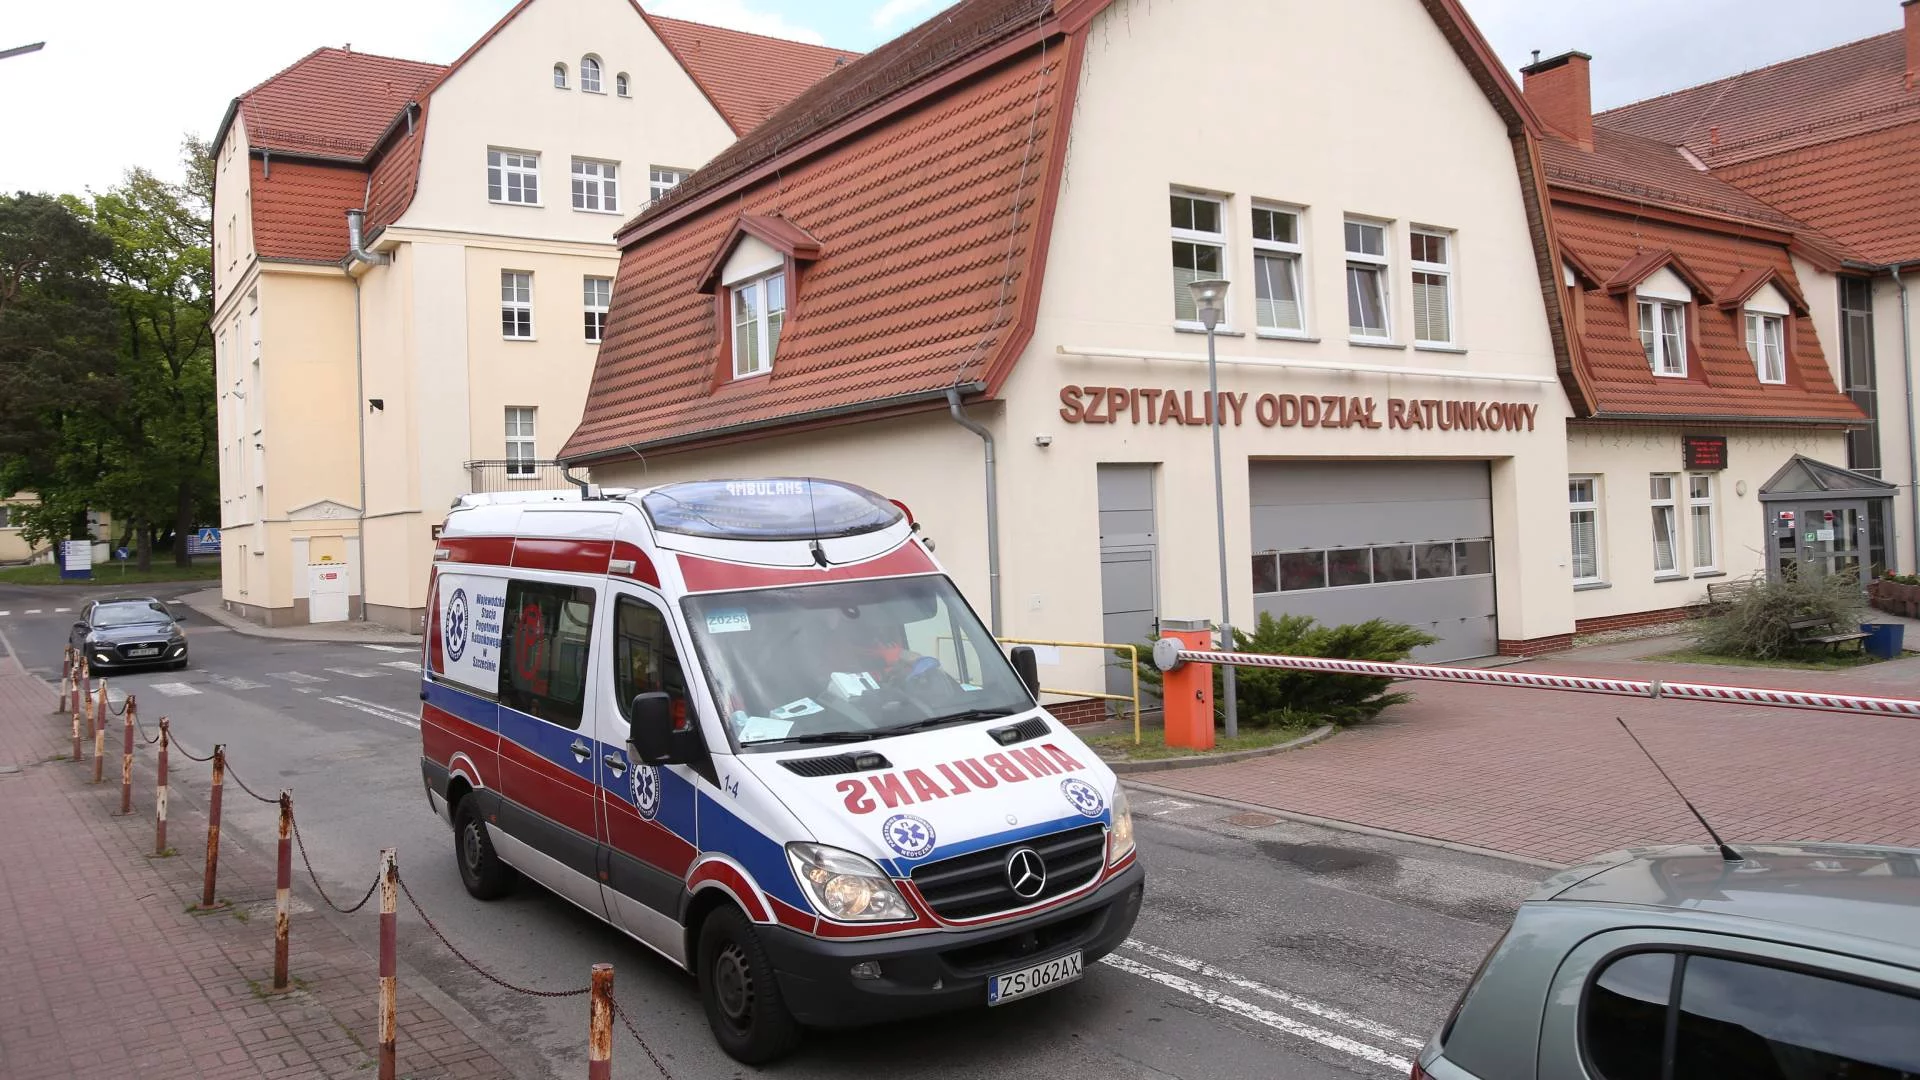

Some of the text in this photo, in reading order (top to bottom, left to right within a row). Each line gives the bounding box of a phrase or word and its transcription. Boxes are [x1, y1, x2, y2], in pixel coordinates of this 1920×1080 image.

[1059, 385, 1539, 433] SZPITALNY ODDZIAŁ RATUNKOWY
[726, 481, 803, 496] AMBULANS
[481, 607, 496, 620] Stacja
[475, 619, 500, 634] Pogotowia
[472, 656, 497, 673] Szczecinie
[724, 774, 739, 799] 1-4
[1000, 954, 1081, 998] ZS 062AX
